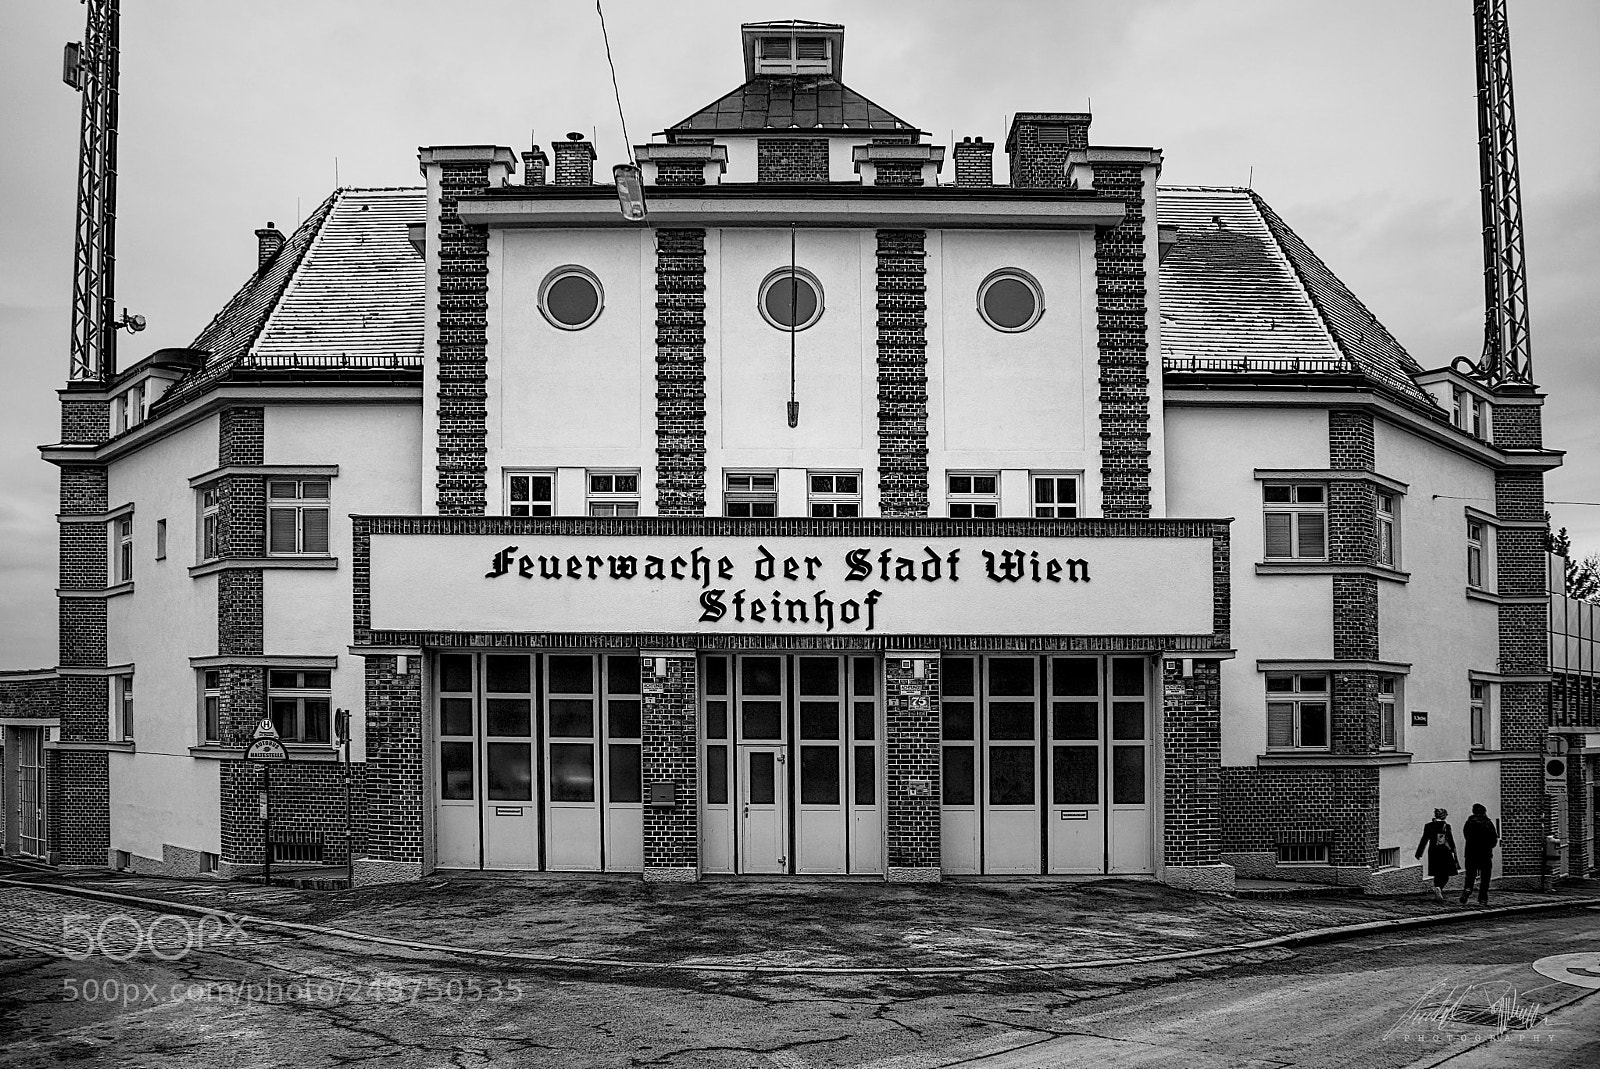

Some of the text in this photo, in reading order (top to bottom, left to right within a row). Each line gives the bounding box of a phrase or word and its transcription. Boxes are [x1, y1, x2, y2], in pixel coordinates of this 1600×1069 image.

[485, 545, 1091, 589] Feuerwache der Stadt Wien
[698, 589, 883, 632] Steinhof
[911, 696, 927, 706] 75
[263, 720, 270, 728] H
